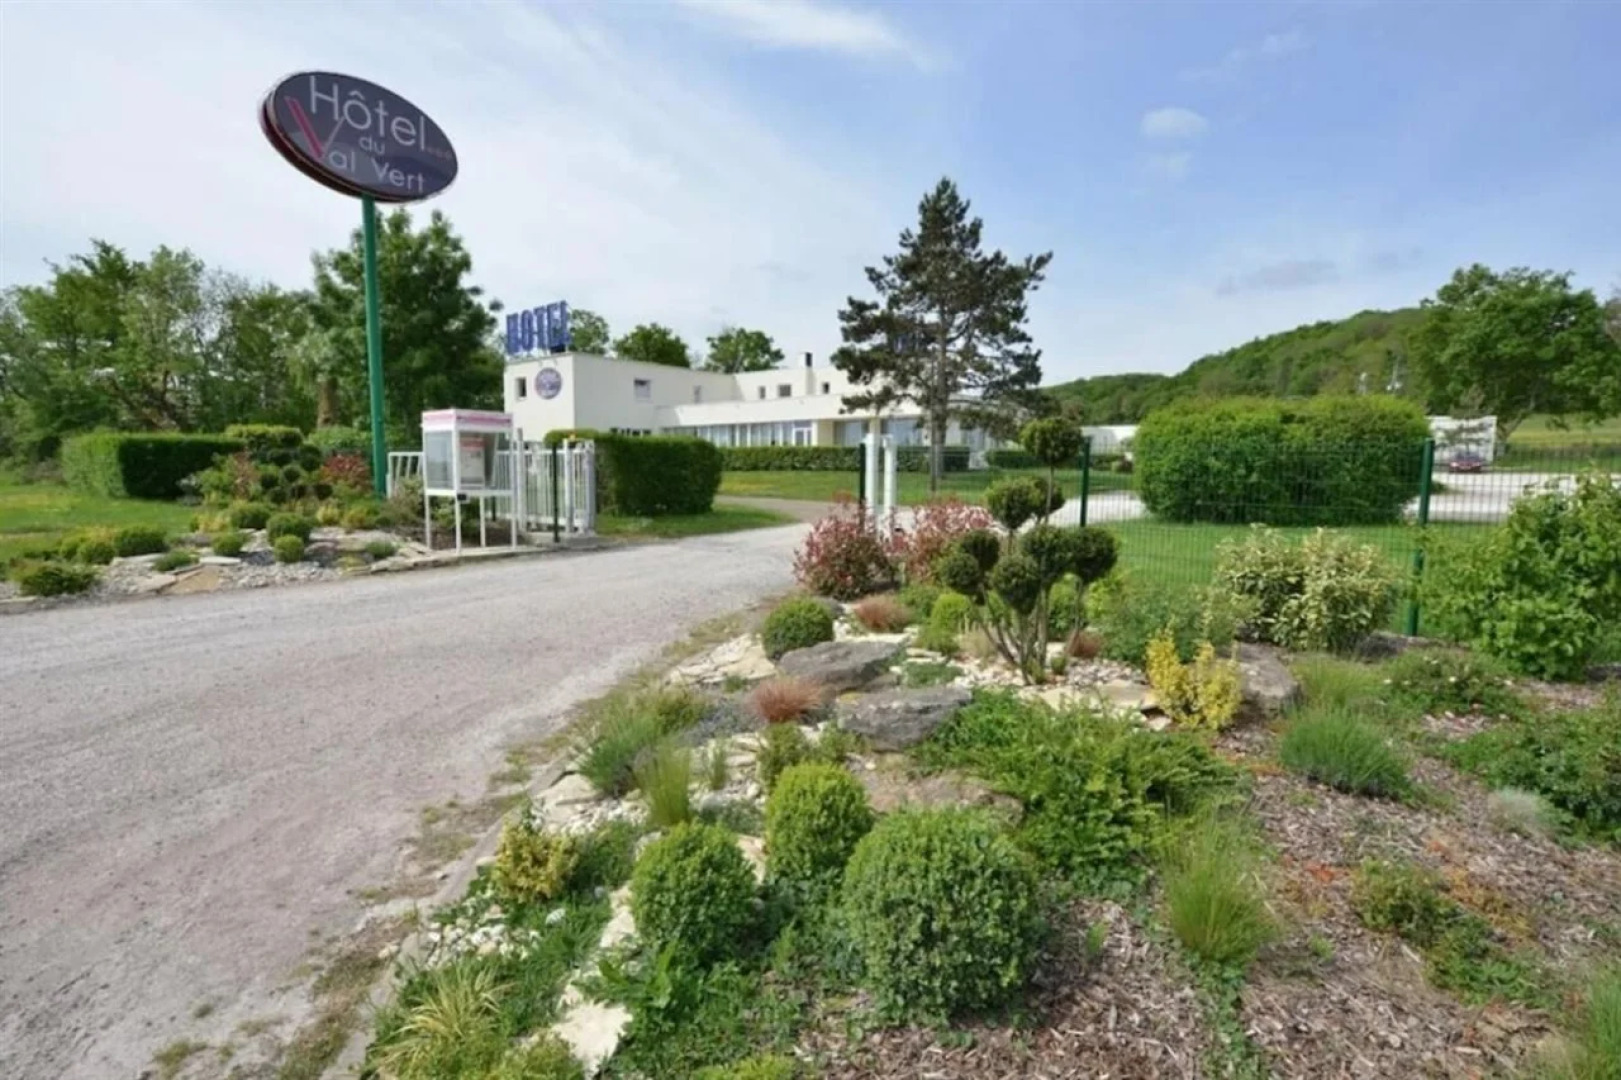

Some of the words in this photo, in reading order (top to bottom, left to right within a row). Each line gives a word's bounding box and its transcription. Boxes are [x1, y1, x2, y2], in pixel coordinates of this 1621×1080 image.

[284, 95, 356, 173] Val
[371, 157, 424, 192] Vert
[310, 75, 425, 151] Hôtel
[359, 135, 386, 155] du
[506, 300, 571, 355] HOTEL
